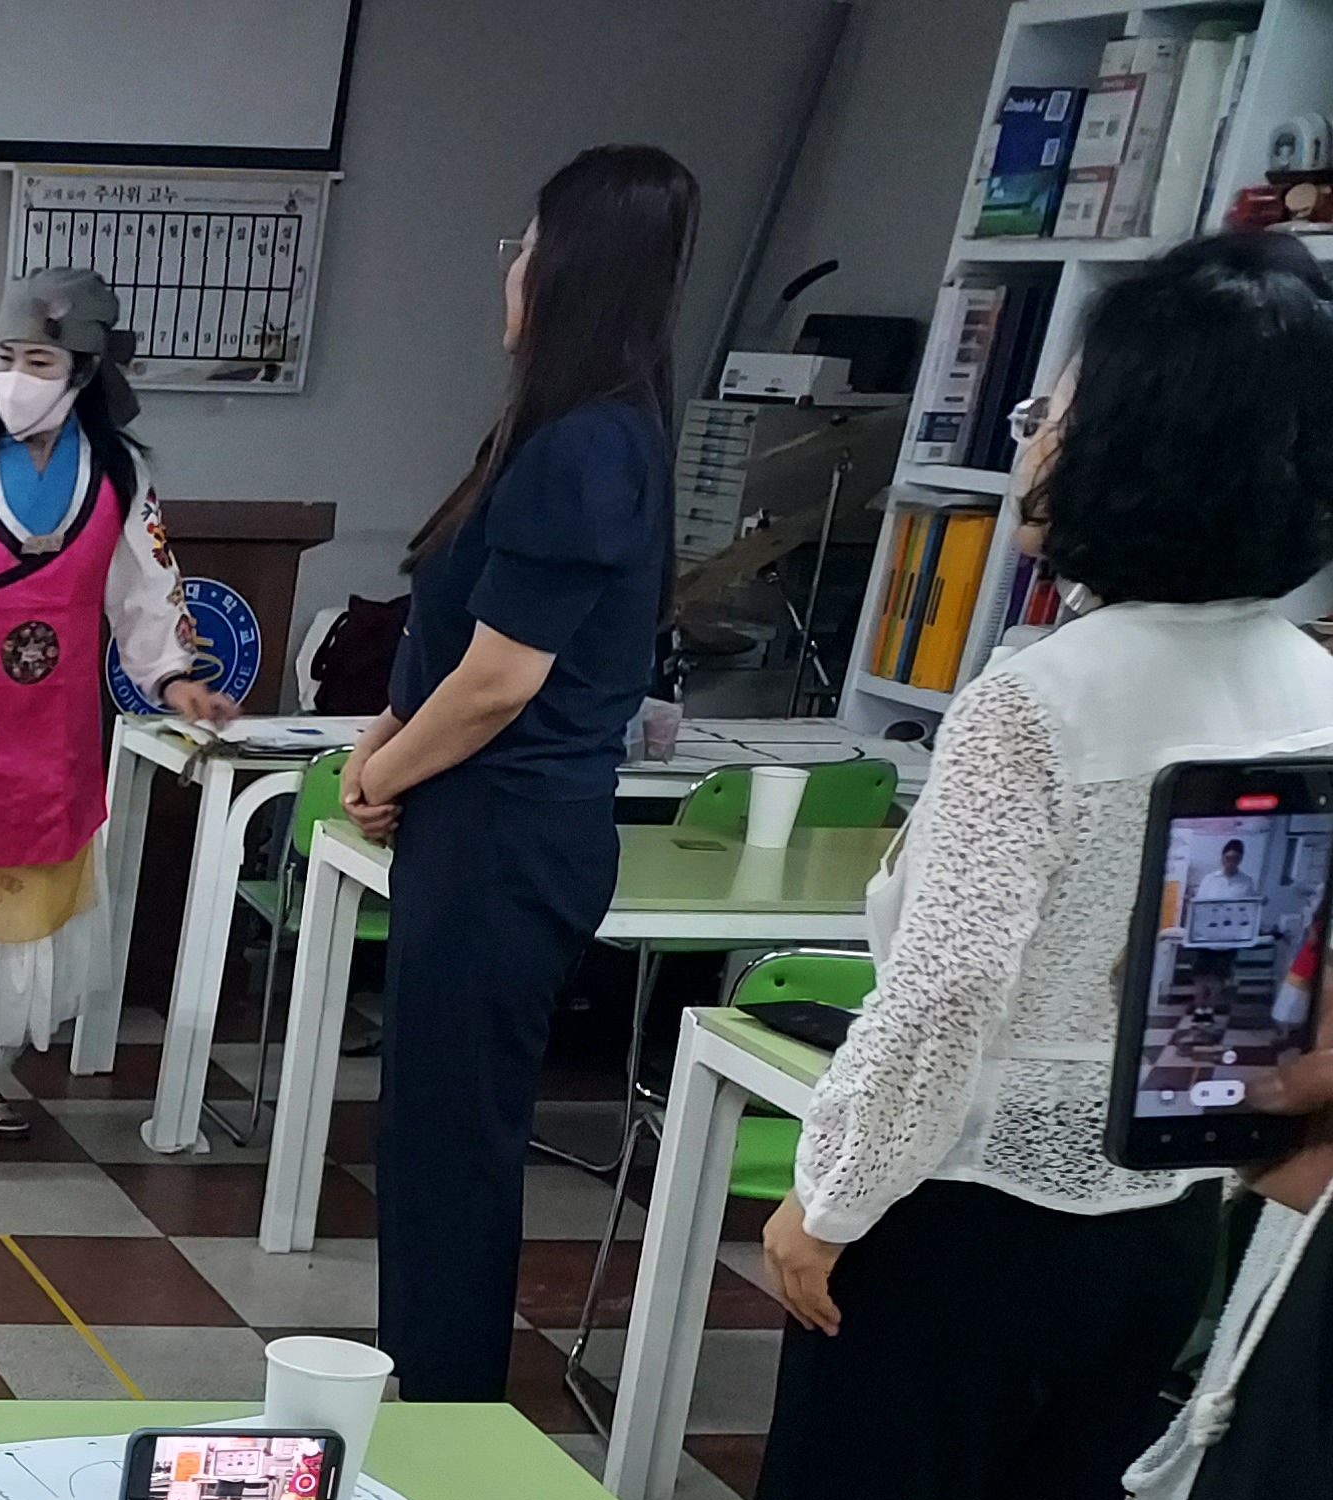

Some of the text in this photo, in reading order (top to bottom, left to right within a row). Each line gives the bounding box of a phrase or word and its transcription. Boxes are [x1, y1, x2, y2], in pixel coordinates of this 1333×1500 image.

[92, 184, 141, 204] 주사위
[146, 186, 179, 204] 고누
[159, 331, 168, 343] 7
[203, 333, 212, 345] 9
[222, 333, 238, 345] 10
